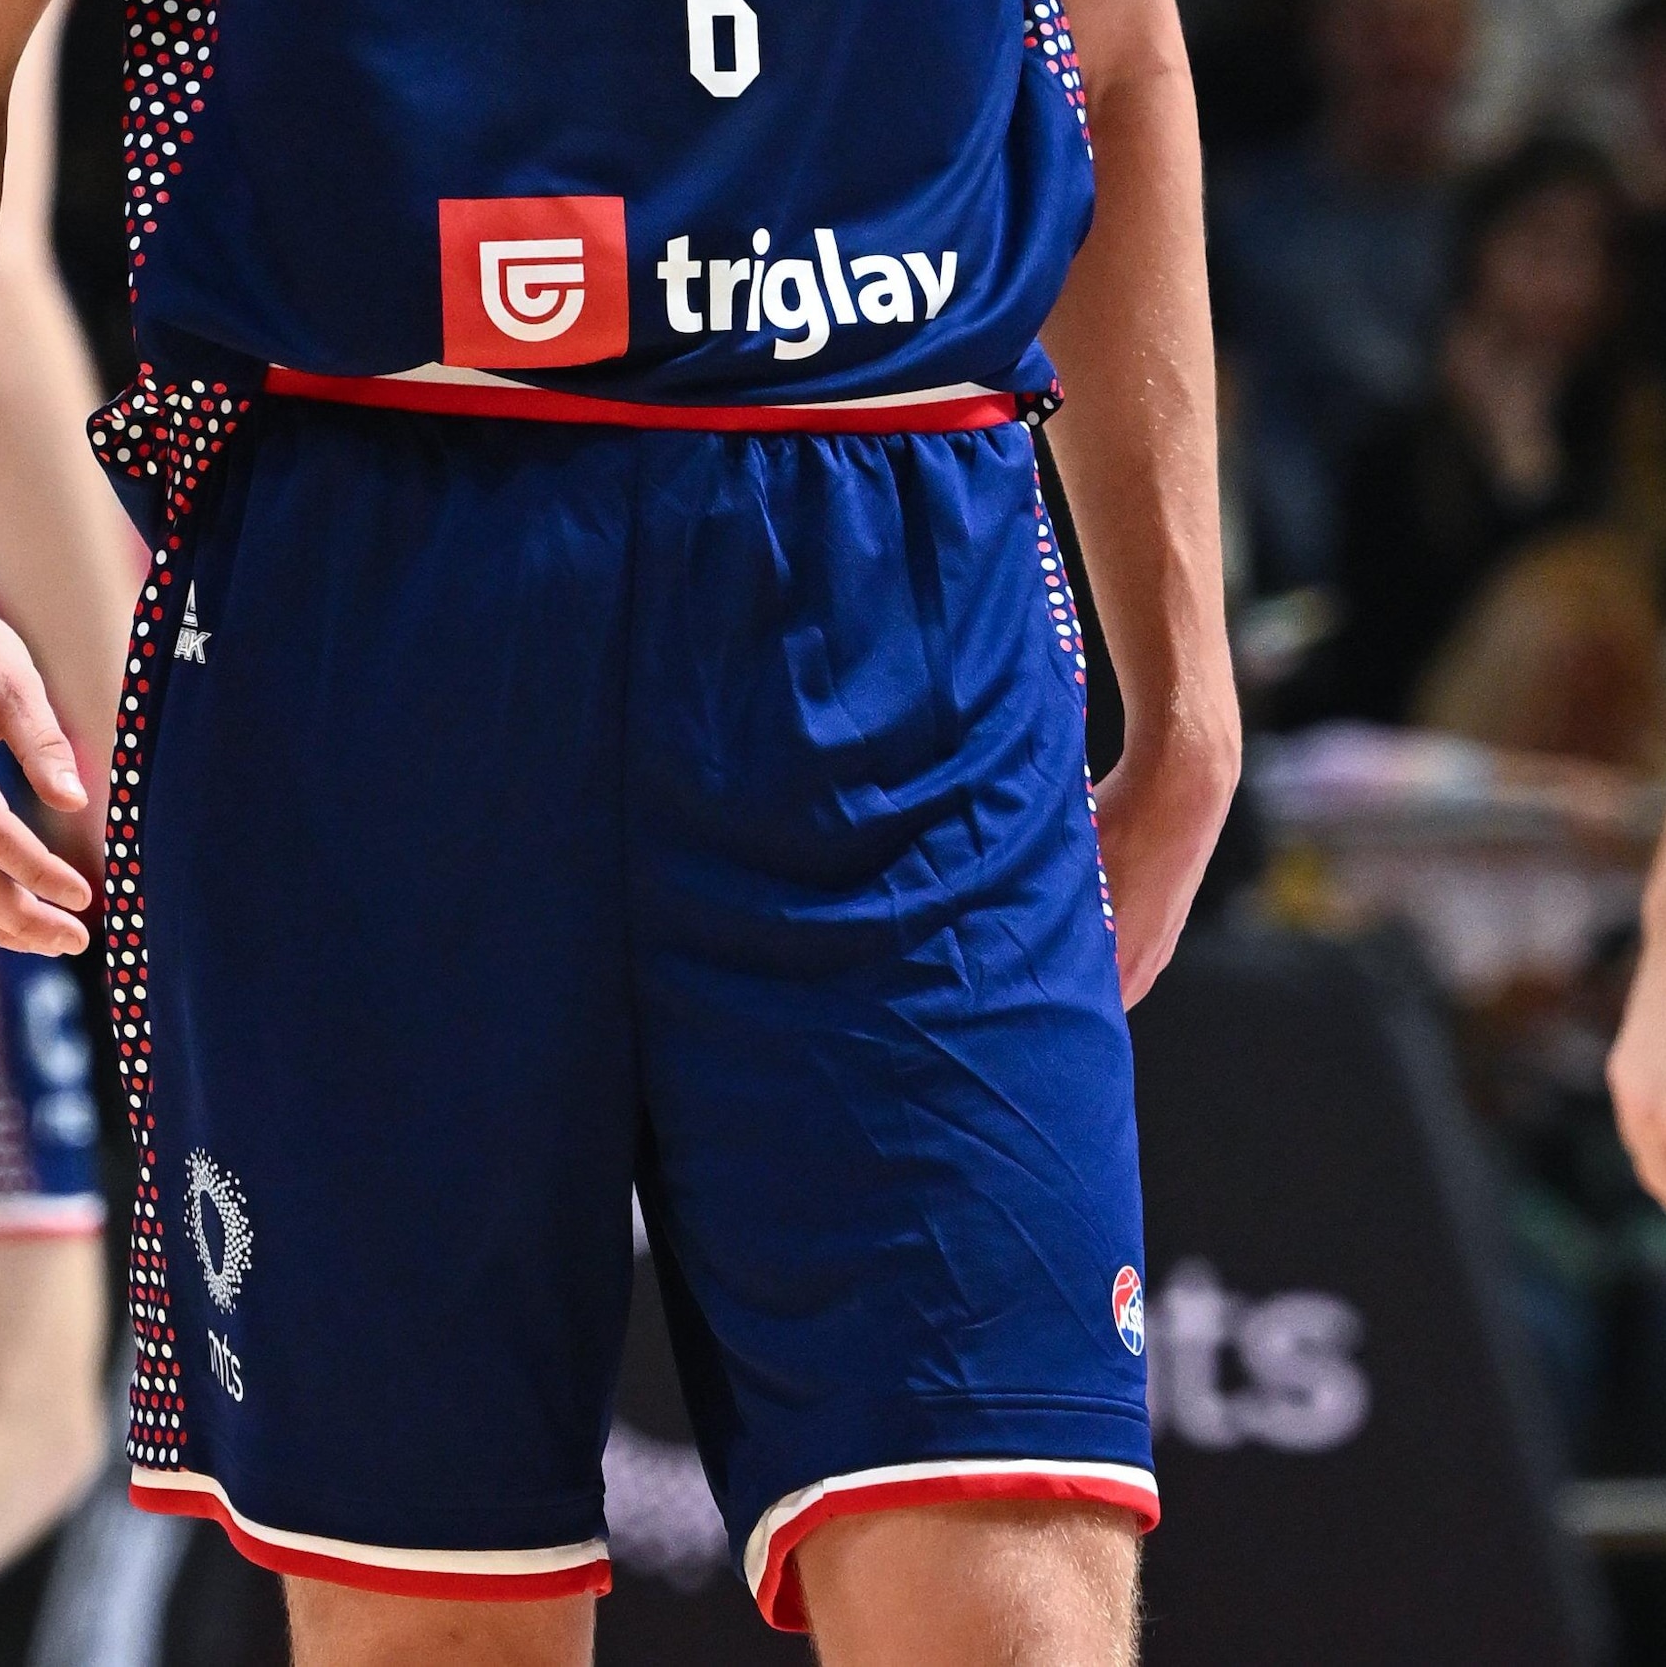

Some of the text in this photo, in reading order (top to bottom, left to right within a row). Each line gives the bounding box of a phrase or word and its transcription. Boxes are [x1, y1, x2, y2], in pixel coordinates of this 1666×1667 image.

[656, 227, 958, 361] triglav
[207, 1326, 244, 1403] mts
[1146, 1252, 1373, 1451] ts
